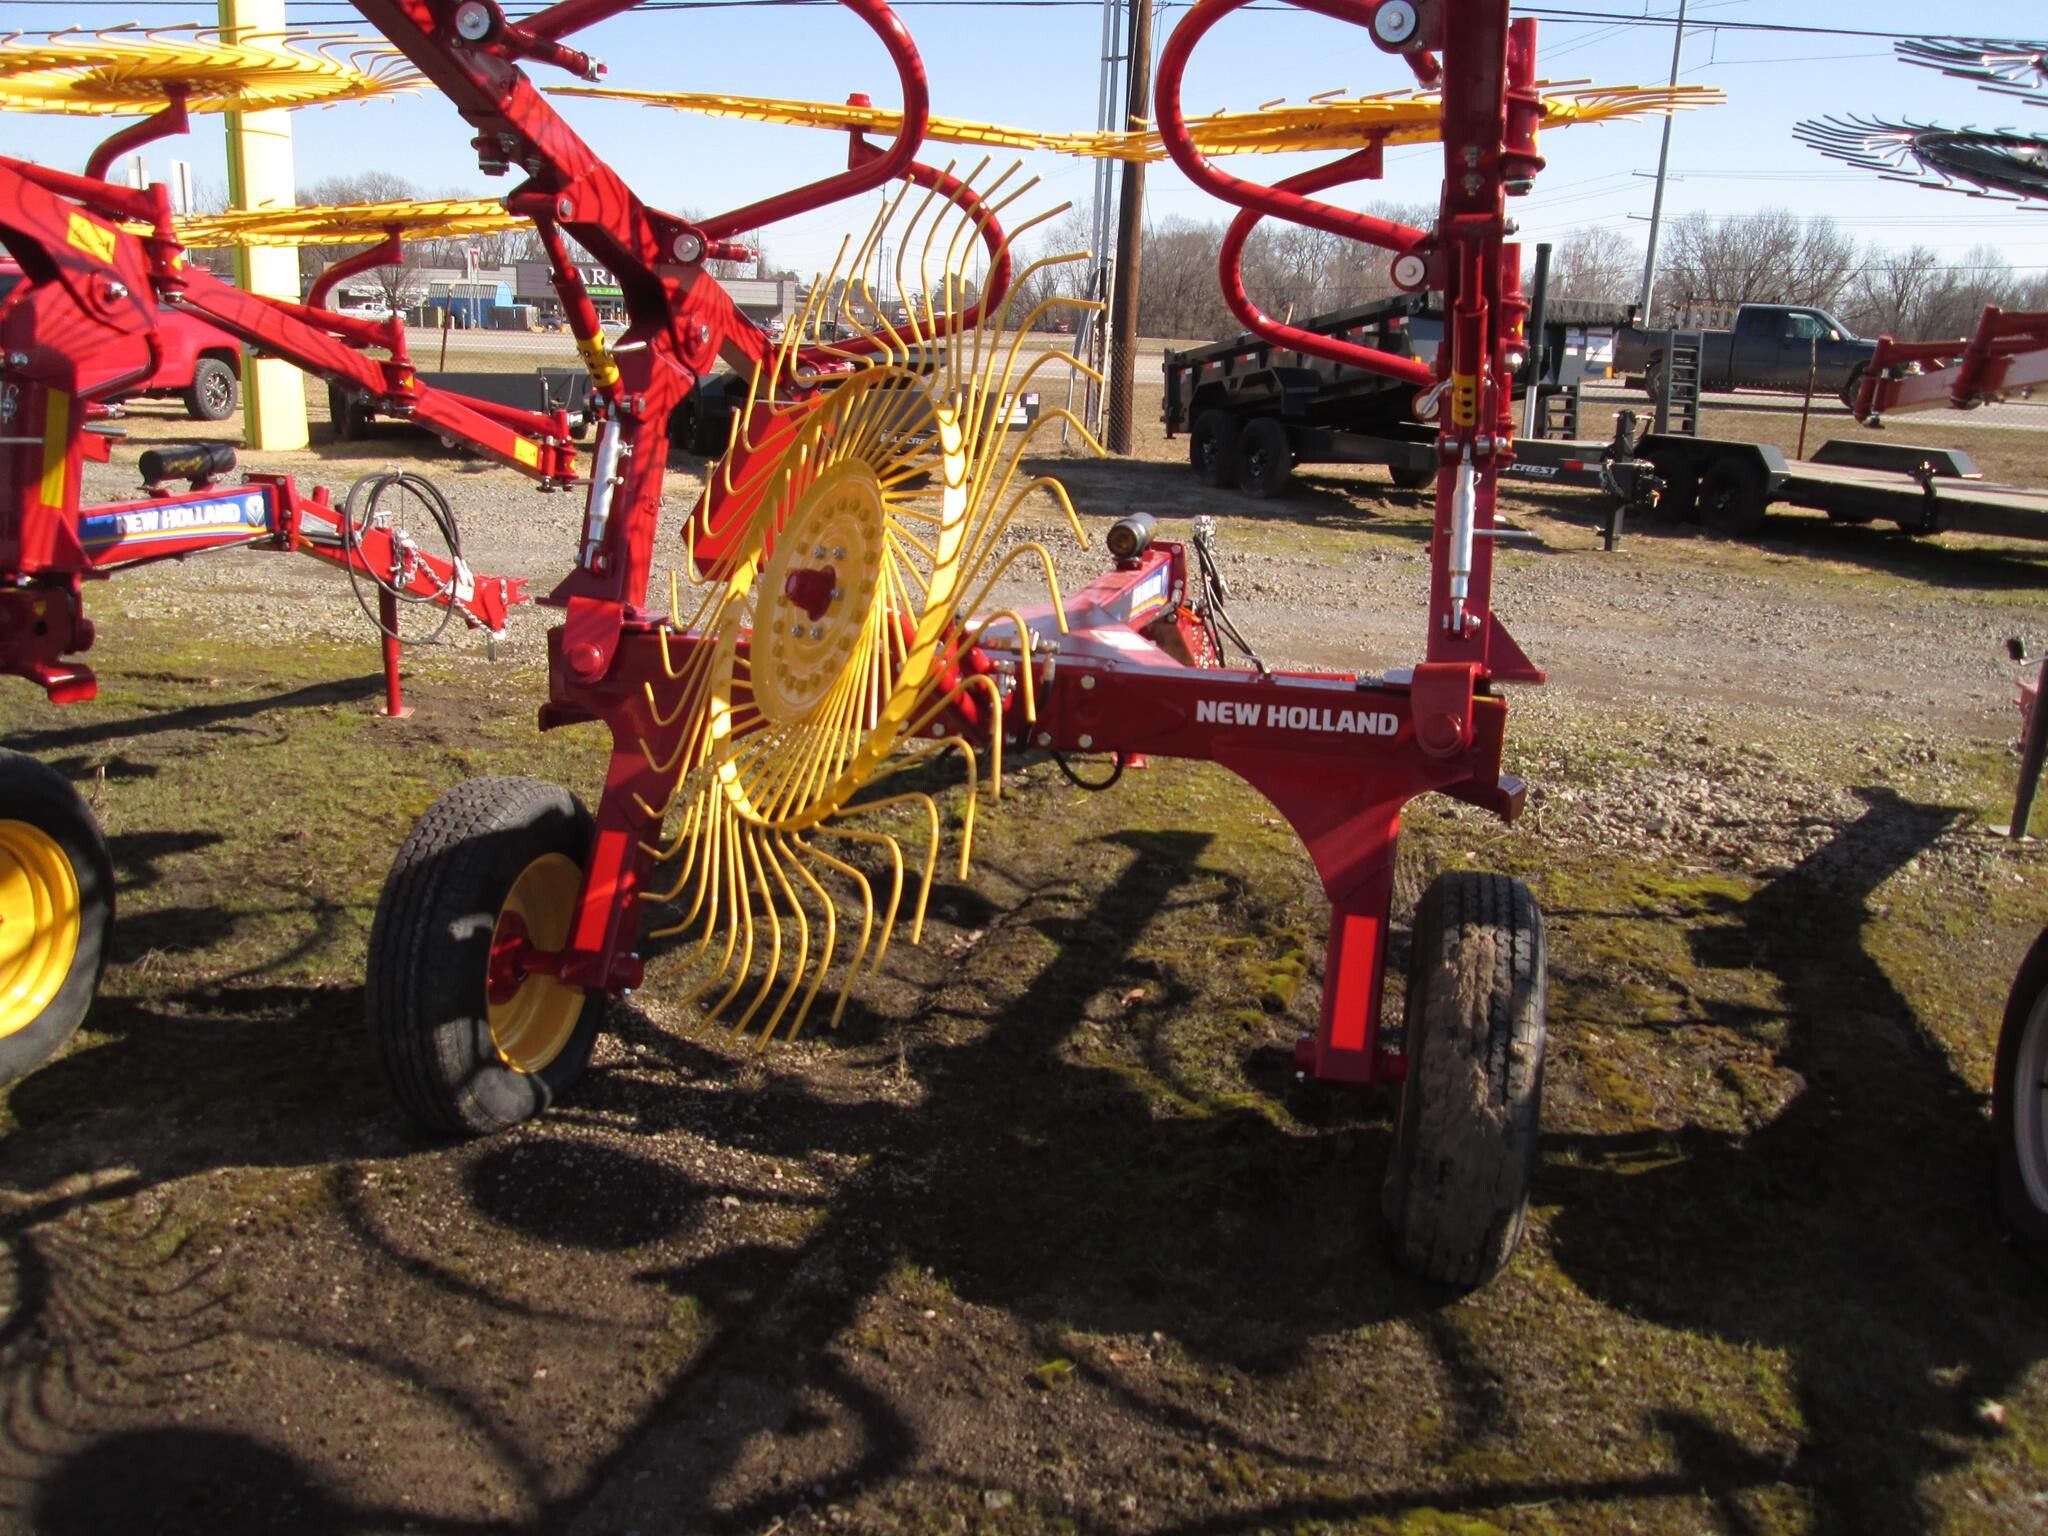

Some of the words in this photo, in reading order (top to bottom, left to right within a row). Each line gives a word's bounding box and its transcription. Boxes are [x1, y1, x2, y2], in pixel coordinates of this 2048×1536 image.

[116, 511, 159, 534] NEW
[162, 503, 241, 529] HOLLAND
[1196, 700, 1261, 726] NEW
[1266, 705, 1399, 736] HOLLAND
